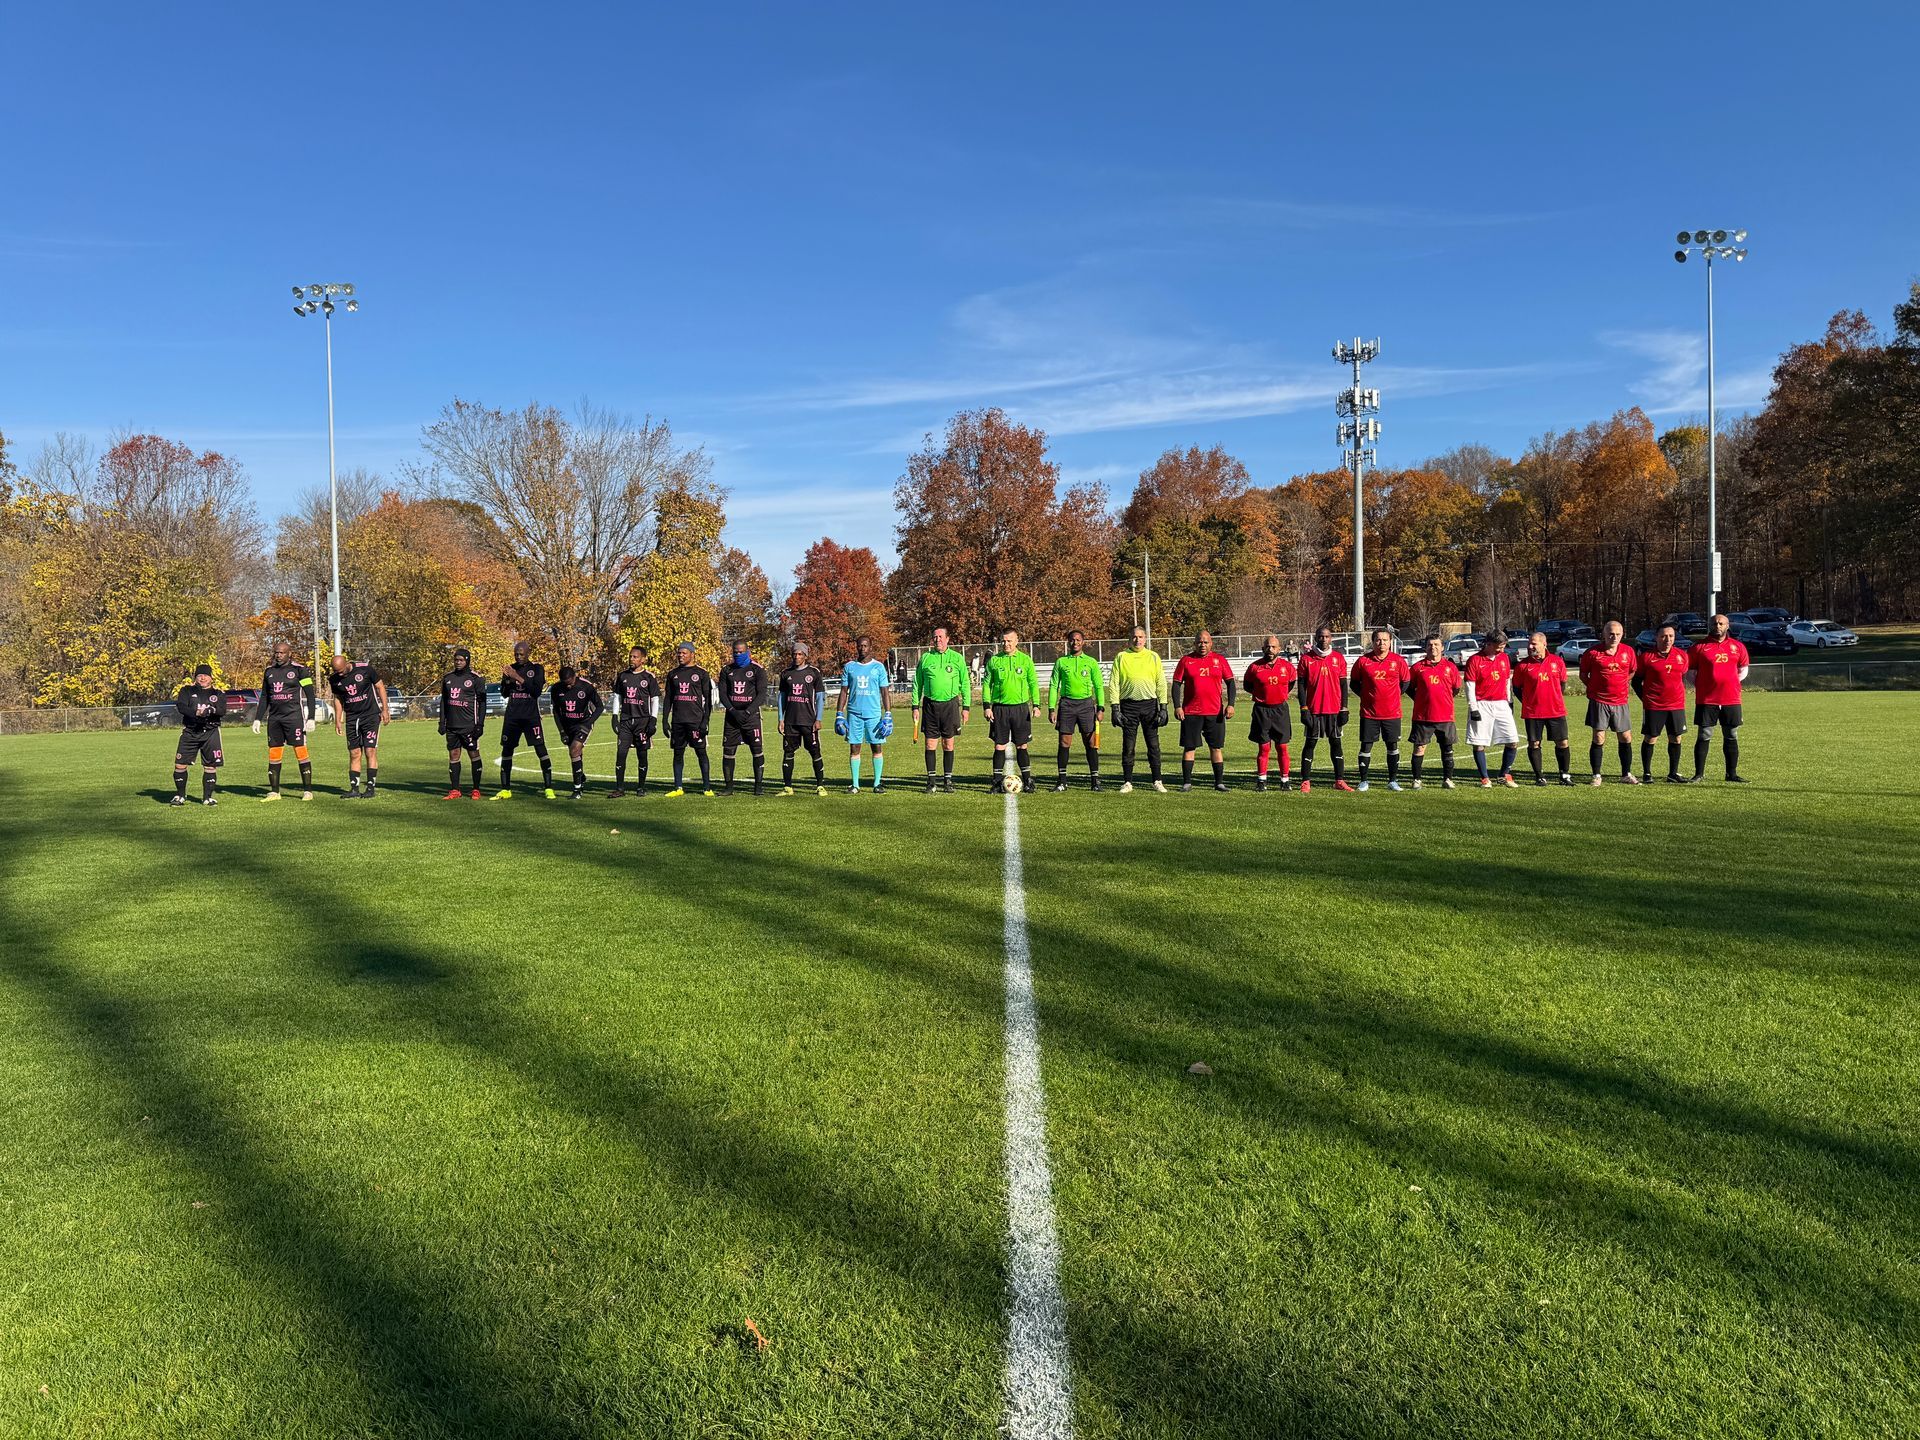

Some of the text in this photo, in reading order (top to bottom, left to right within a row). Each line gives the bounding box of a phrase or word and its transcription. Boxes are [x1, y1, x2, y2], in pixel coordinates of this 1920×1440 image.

[1715, 653, 1729, 663] 25
[1199, 667, 1210, 677] 21
[1665, 664, 1672, 674] 7
[1268, 675, 1279, 685] 13
[1374, 670, 1387, 680] 22
[1490, 671, 1500, 681] 15
[1538, 672, 1549, 682] 14
[295, 728, 301, 737] 5
[366, 730, 377, 740] 24
[532, 726, 540, 736] 17
[753, 728, 760, 737] 11
[213, 749, 222, 758] 10
